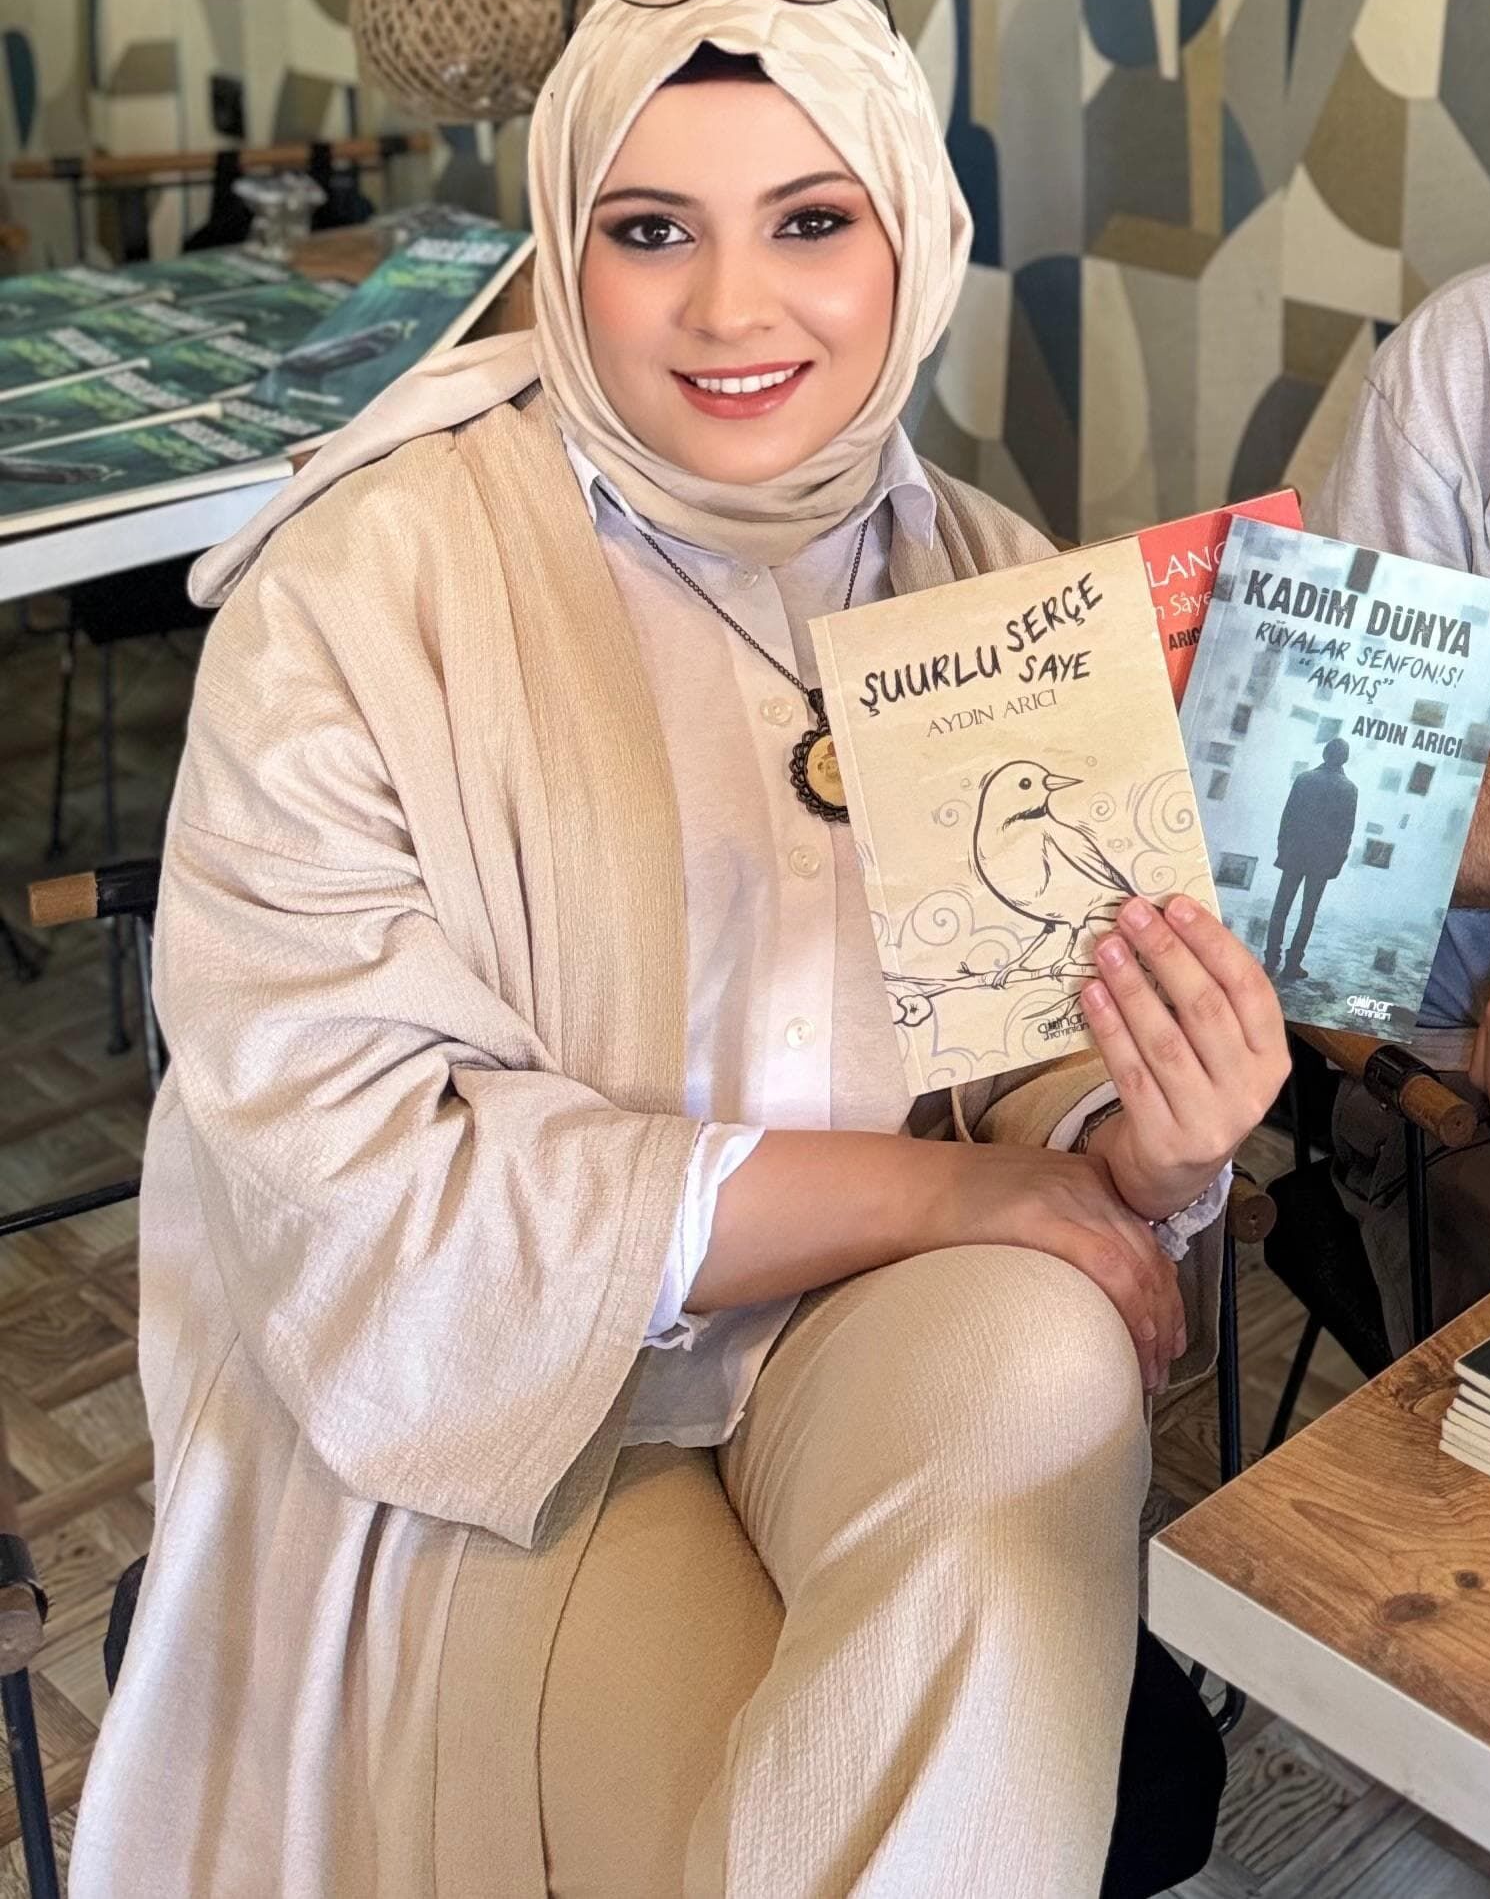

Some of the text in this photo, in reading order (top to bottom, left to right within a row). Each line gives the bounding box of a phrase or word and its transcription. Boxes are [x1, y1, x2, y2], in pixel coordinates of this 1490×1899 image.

[1244, 569, 1472, 658] KADİM DÜNYA
[859, 571, 1104, 717] ŞUURLU SERÇE
[1255, 620, 1351, 661] RÜYALAR
[1018, 649, 1093, 685] SAYE
[926, 688, 1058, 739] AYDIN ARICI
[1351, 714, 1465, 759] AYDIN ARICI
